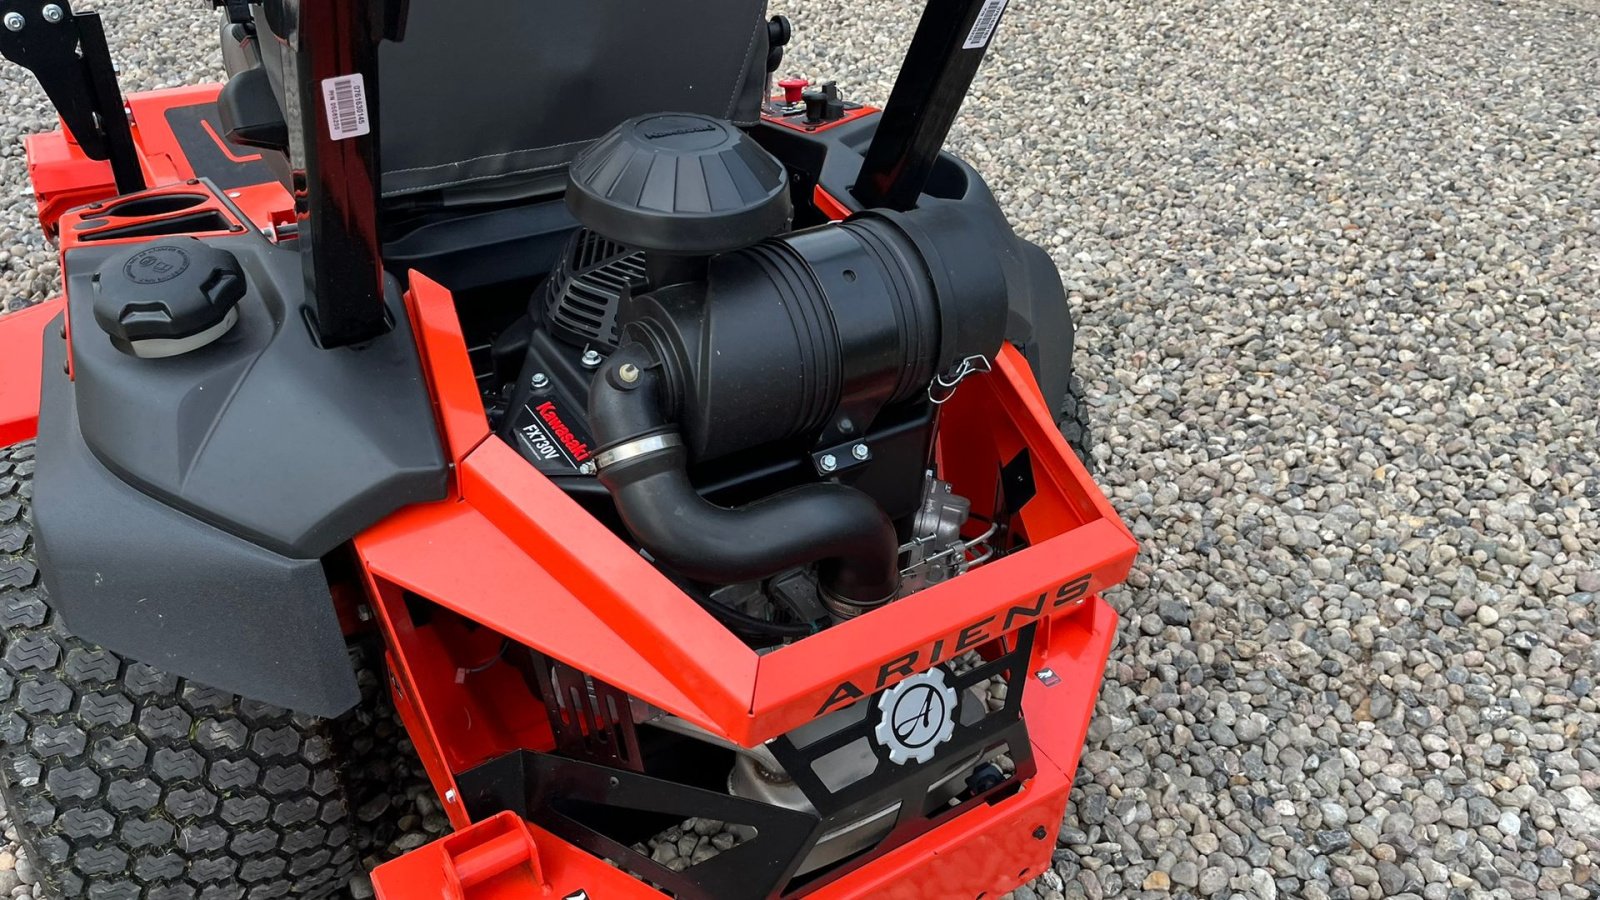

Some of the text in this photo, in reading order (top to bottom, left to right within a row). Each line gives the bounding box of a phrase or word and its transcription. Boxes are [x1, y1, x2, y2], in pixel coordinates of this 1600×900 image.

[522, 424, 560, 460] FX730V
[535, 401, 591, 461] Kawasaki
[814, 573, 1092, 718] ARIENS
